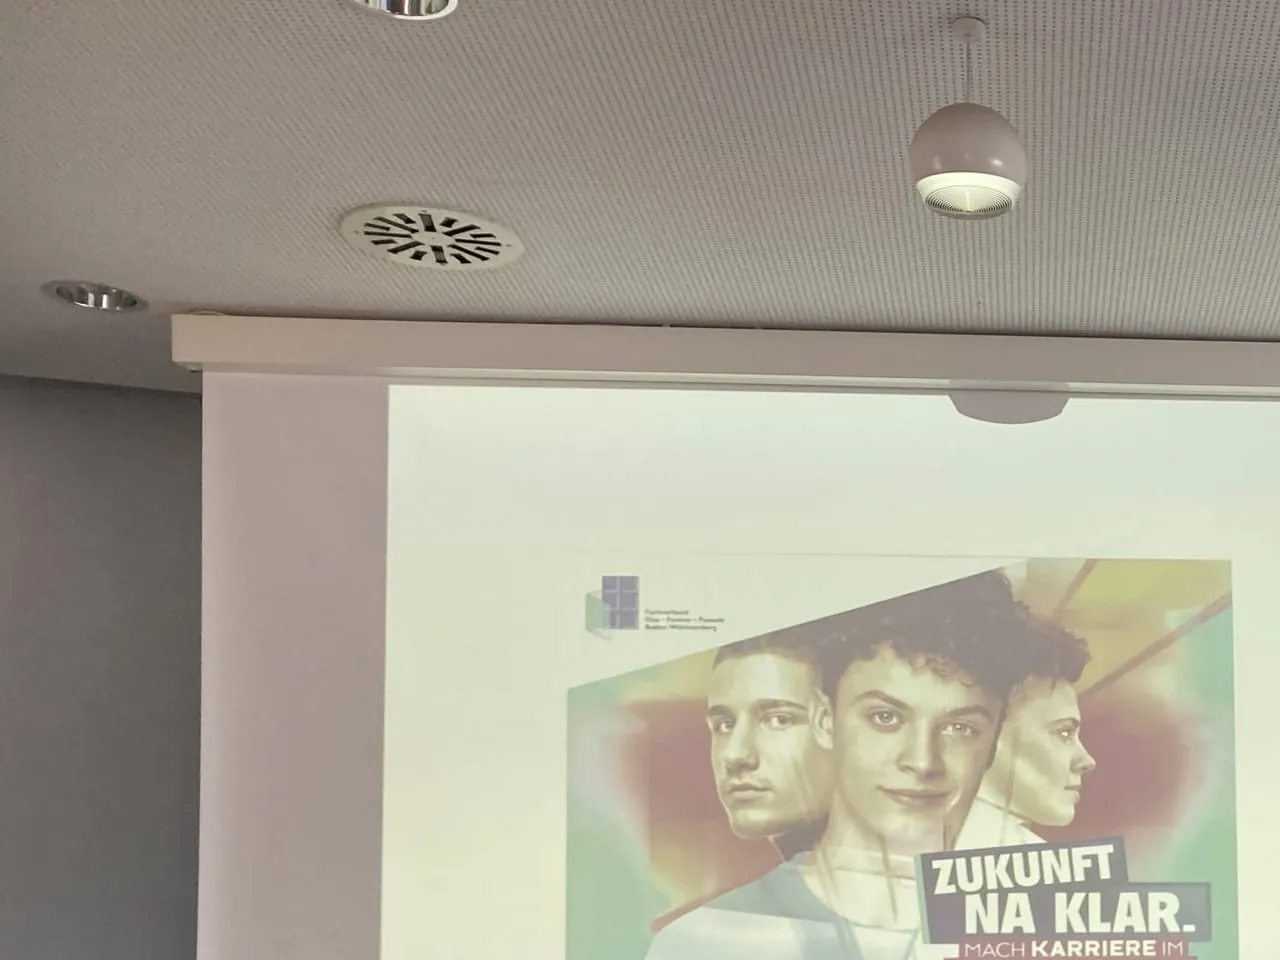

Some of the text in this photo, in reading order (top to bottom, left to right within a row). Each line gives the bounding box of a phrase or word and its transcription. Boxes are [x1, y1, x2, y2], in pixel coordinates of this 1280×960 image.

[932, 844, 1114, 895] ZUKUNFT
[965, 891, 1196, 934] NA KLAR.
[964, 940, 1183, 958] MACH KARRIERE IM
